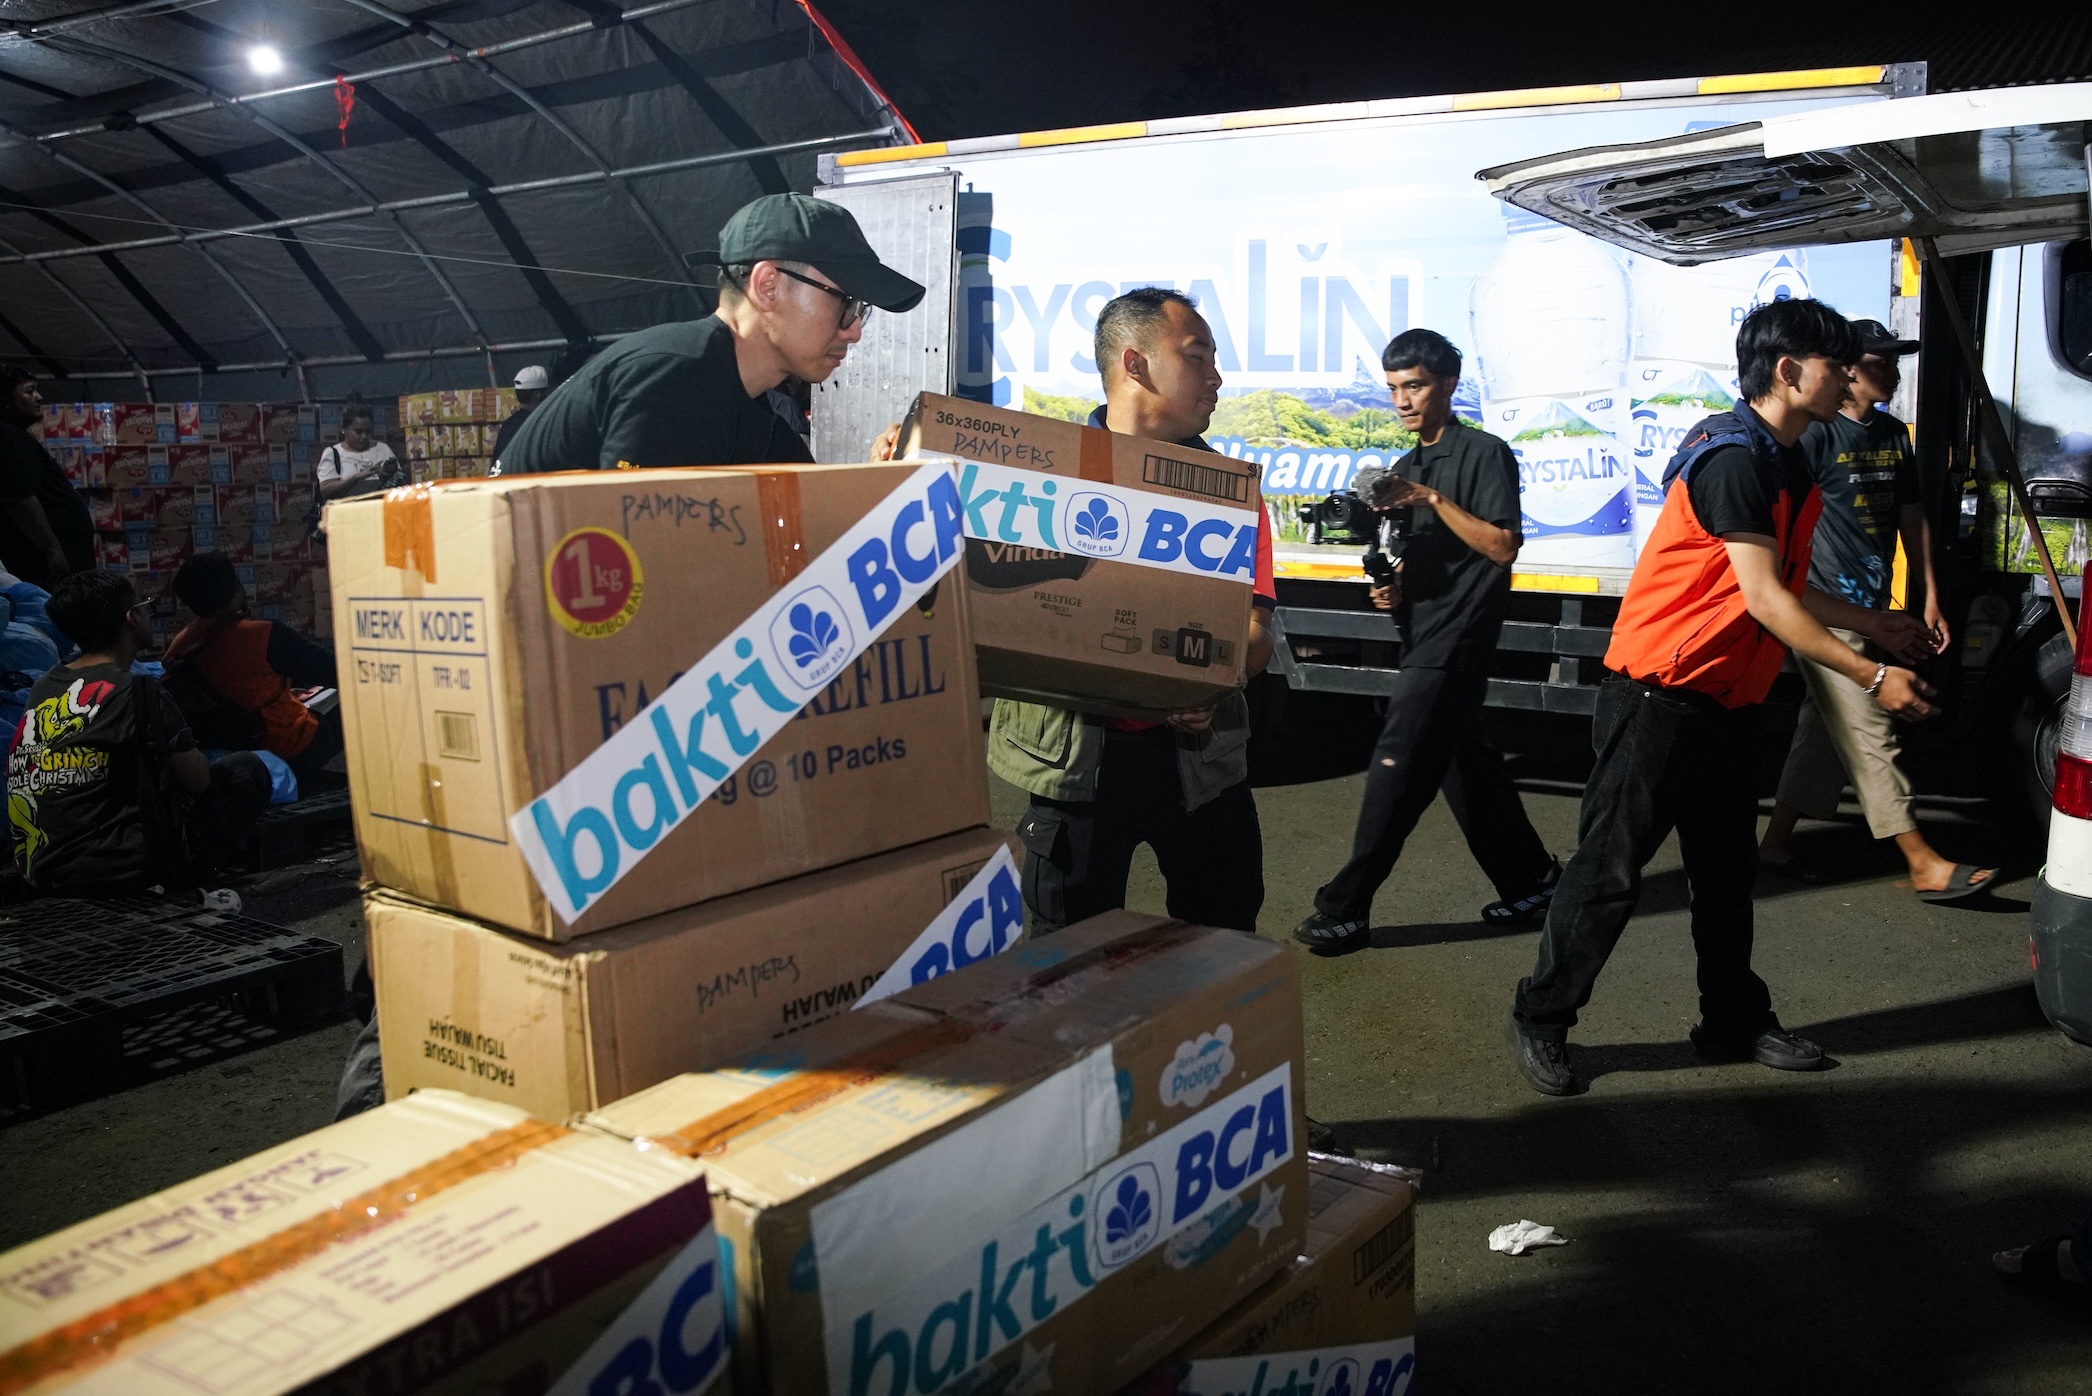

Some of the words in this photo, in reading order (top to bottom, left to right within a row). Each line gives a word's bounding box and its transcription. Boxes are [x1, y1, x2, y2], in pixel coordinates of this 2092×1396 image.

[936, 411, 1021, 439] 36x360PLY
[953, 431, 1056, 469] PAMPERS
[621, 493, 748, 546] PAMPERS
[959, 464, 1062, 551] kti
[1077, 540, 1097, 551] GRUP
[1099, 543, 1113, 552] BCA
[574, 614, 628, 638] JUMBO
[624, 581, 645, 615] BAG
[1033, 591, 1083, 608] PRESTIGE
[1115, 608, 1138, 619] SOFT
[356, 609, 406, 641] MERK
[420, 611, 476, 643] KODE
[1114, 616, 1138, 626] PACK
[1188, 621, 1204, 630] SIZE
[1159, 635, 1170, 649] S
[1183, 635, 1206, 660] M
[1218, 646, 1228, 659] L
[530, 637, 802, 913] bakti
[846, 470, 965, 632] BCA
[787, 750, 818, 783] 10
[827, 735, 908, 774] Packs
[29, 766, 110, 791] CHRISTMAS!
[783, 978, 857, 1024] WAJAH
[428, 1017, 473, 1048] WAJAH
[476, 1033, 508, 1060] TISU
[423, 1039, 467, 1073] TISSUE
[469, 1054, 517, 1088] FACIAL
[1172, 1084, 1290, 1225] BCA
